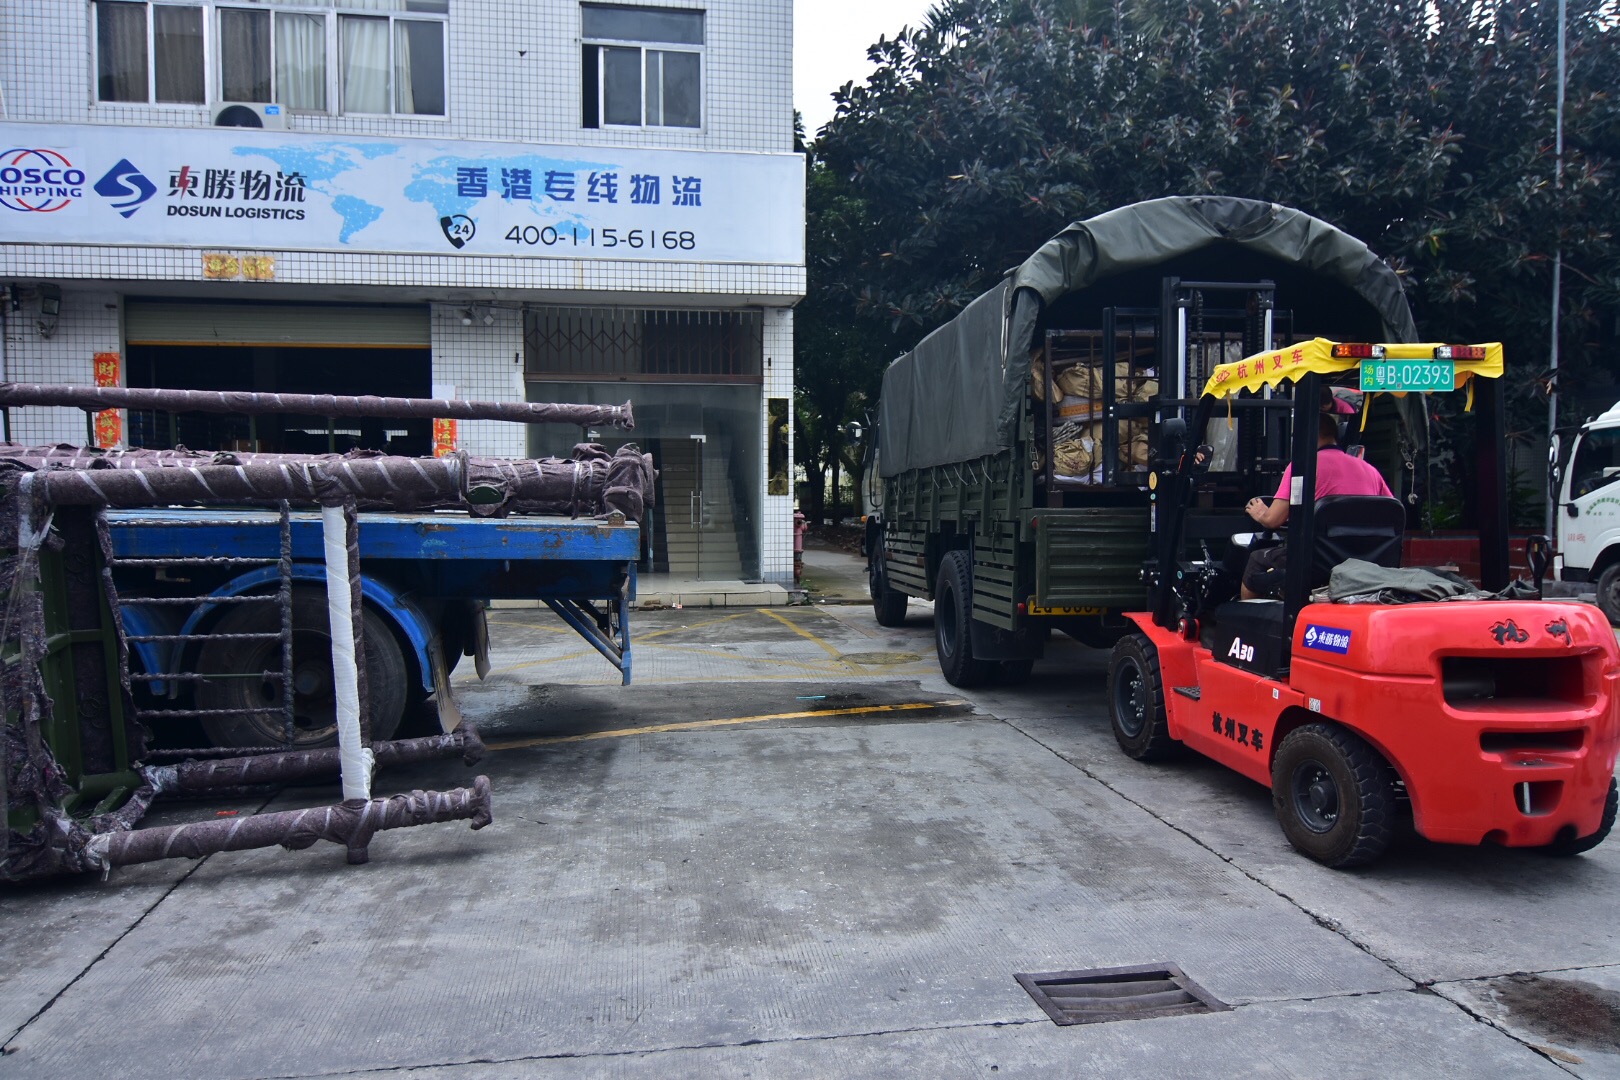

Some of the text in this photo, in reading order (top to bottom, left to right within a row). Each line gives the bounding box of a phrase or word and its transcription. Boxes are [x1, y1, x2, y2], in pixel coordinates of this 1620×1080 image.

[457, 167, 702, 207] 香港专线物流
[167, 205, 306, 221] DOSUN LOGISTICS
[453, 223, 470, 235] 24
[505, 225, 696, 250] 400-115-6168
[1237, 349, 1303, 380] 杭州叉车
[1228, 637, 1254, 662] A30
[1212, 711, 1263, 752] 杭州叉车
